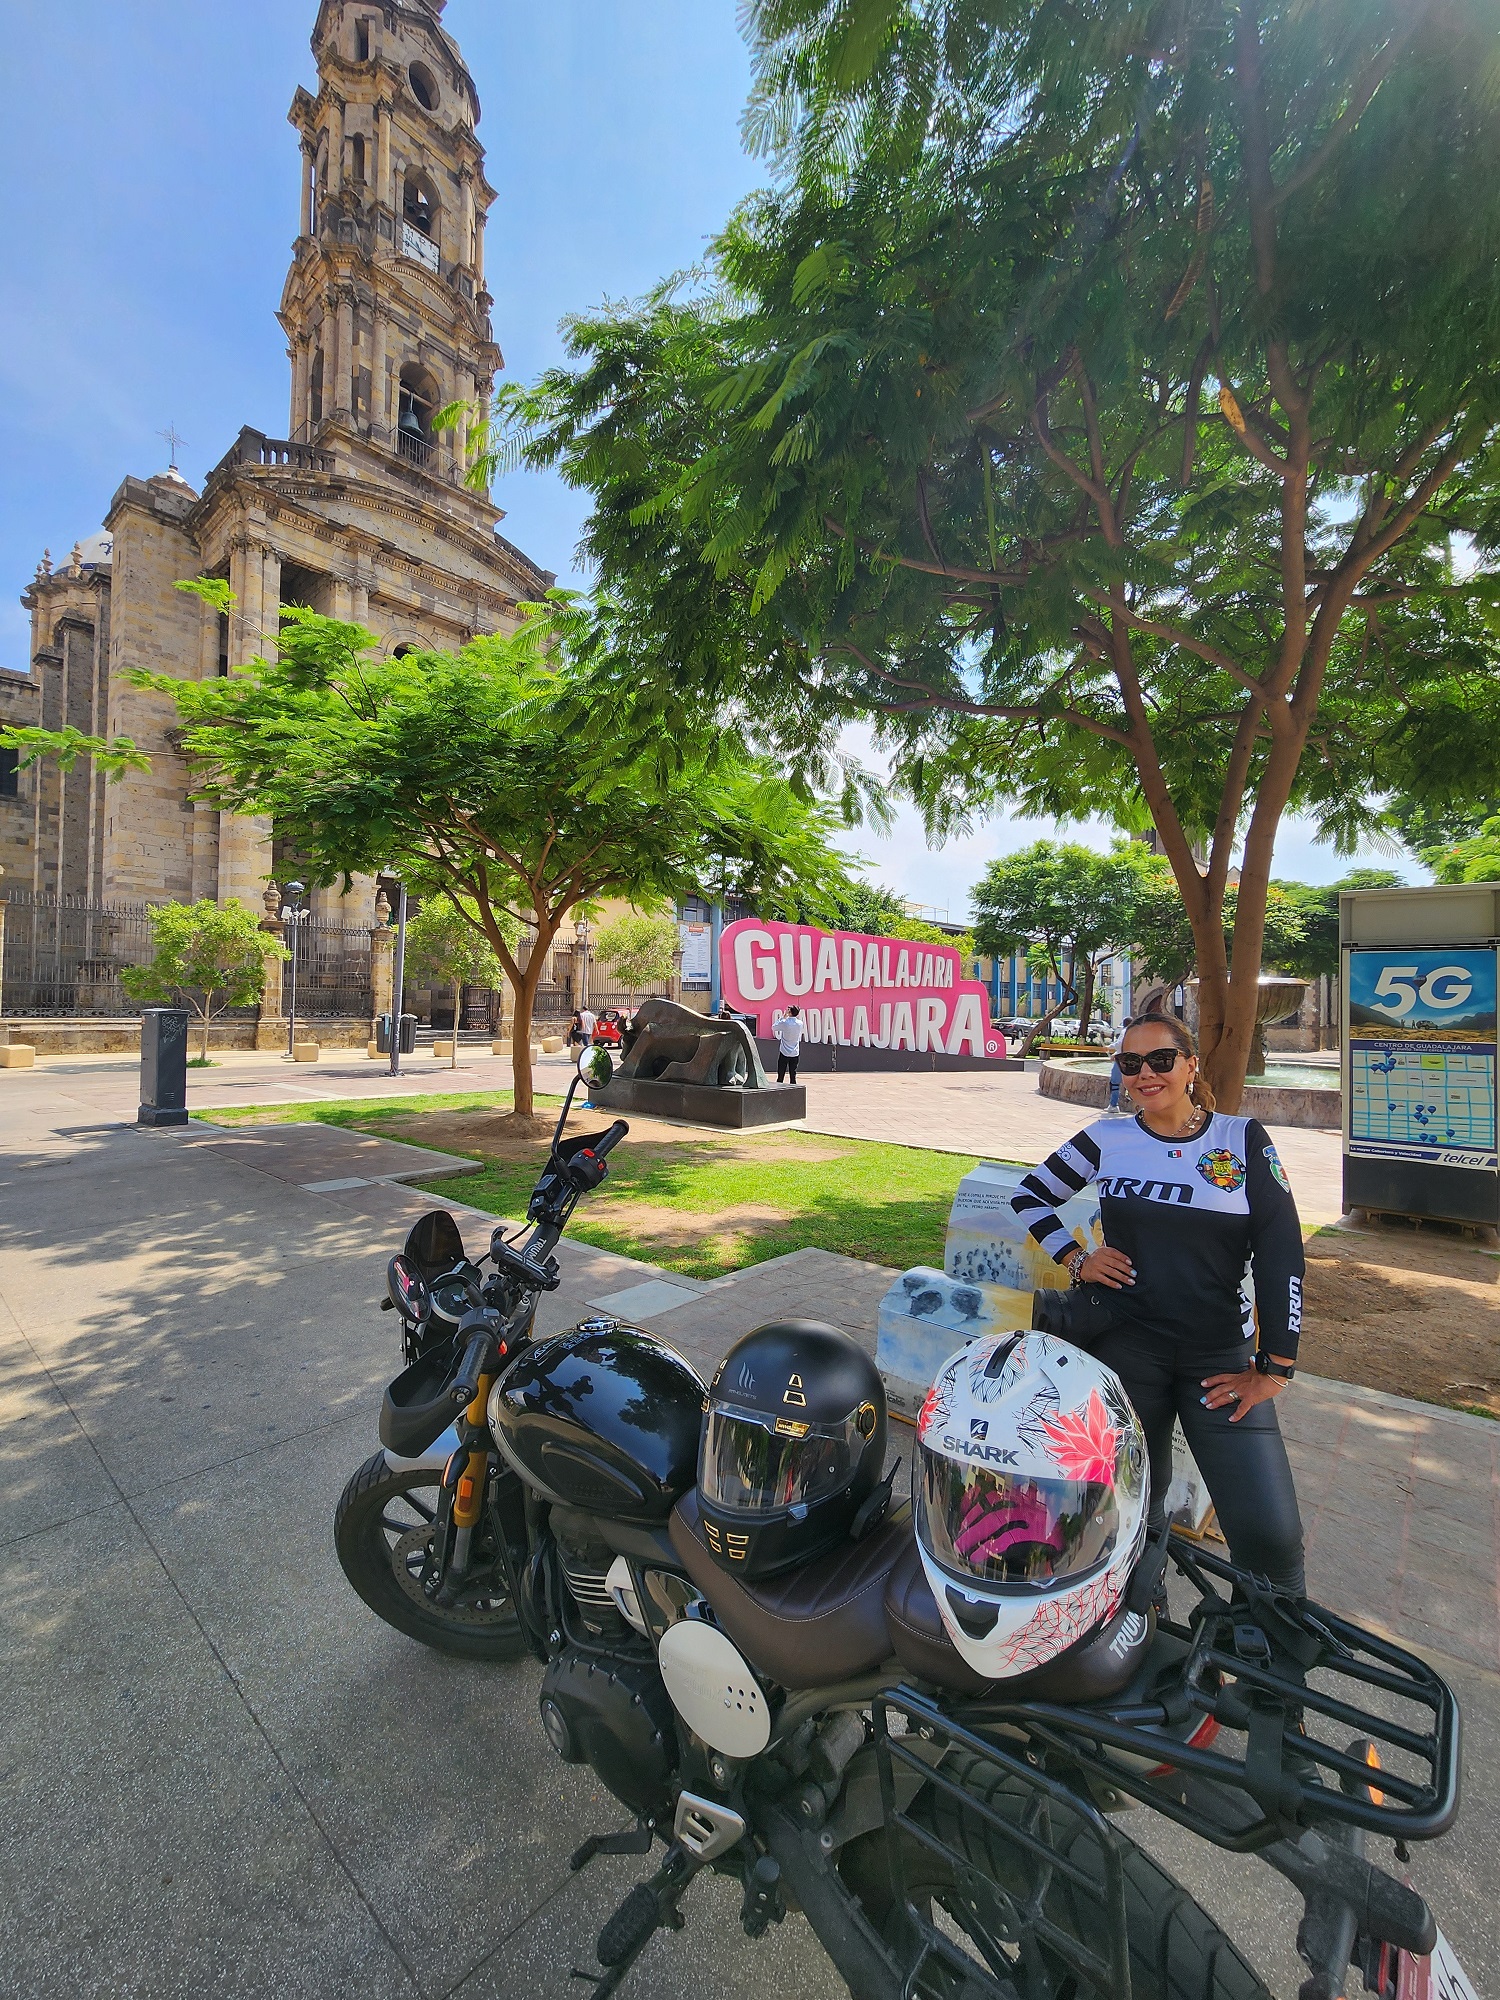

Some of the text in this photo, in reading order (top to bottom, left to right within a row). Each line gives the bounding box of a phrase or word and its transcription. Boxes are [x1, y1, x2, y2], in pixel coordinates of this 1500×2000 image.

[734, 929, 953, 1001] GUADALAJARA
[1370, 965, 1472, 1018] 5G
[771, 994, 985, 1058] GADALAJARA
[1443, 1152, 1485, 1166] telcel
[523, 1238, 547, 1260] TRIUM
[942, 1435, 1020, 1467] SHARK
[1108, 1611, 1148, 1660] TRIUM
